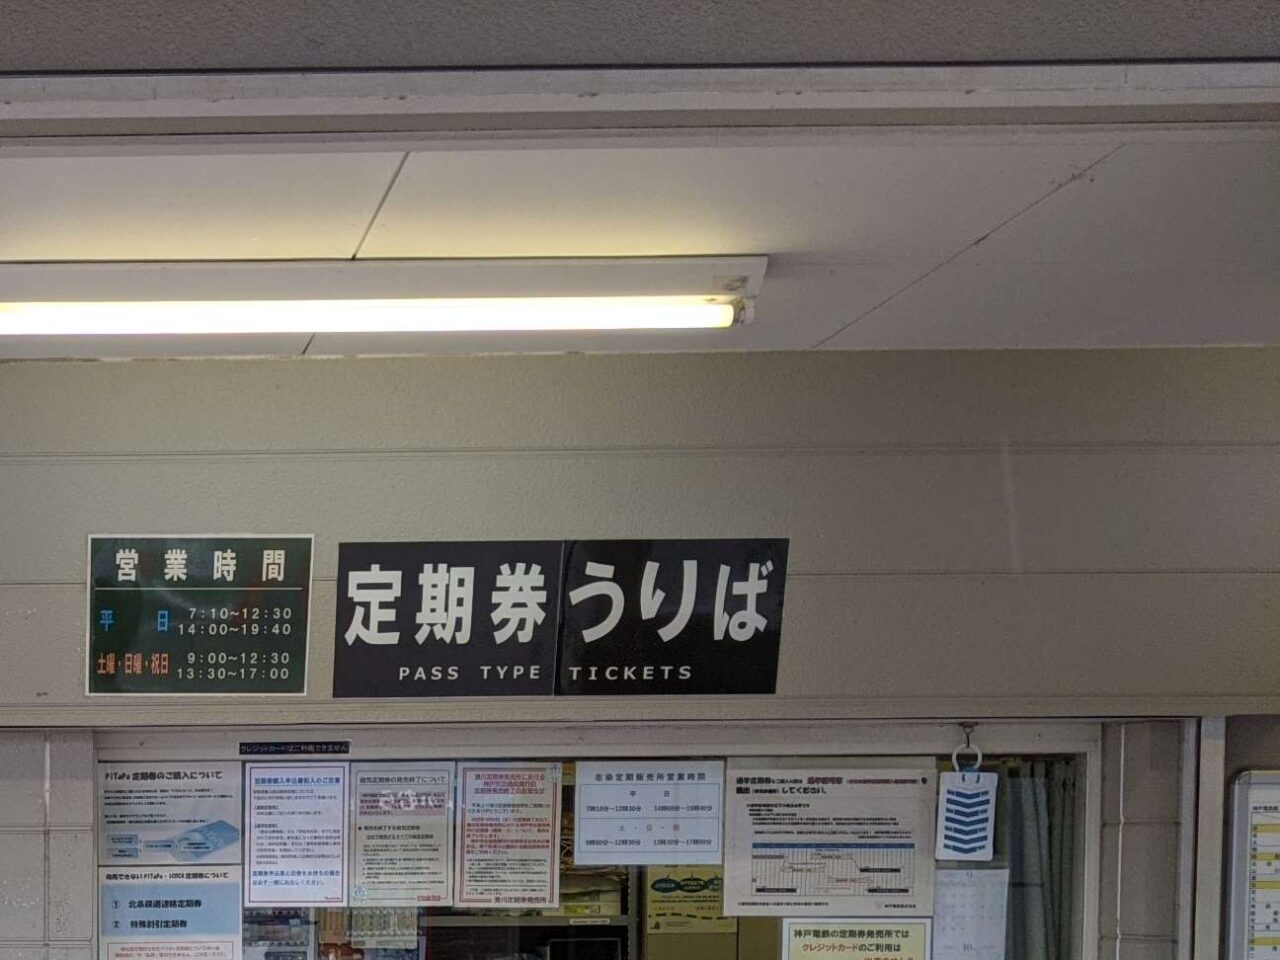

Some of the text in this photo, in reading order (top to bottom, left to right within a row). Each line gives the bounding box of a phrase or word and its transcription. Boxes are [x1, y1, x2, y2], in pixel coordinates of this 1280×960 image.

[116, 549, 285, 581] 営業時間
[344, 559, 774, 646] 定期券うりば
[100, 610, 169, 632] 平日
[97, 653, 169, 674] 土曜・日曜・祝日
[399, 665, 692, 681] PASS TYPE TICKETS
[802, 944, 901, 952] クレジットカードのご利用は
